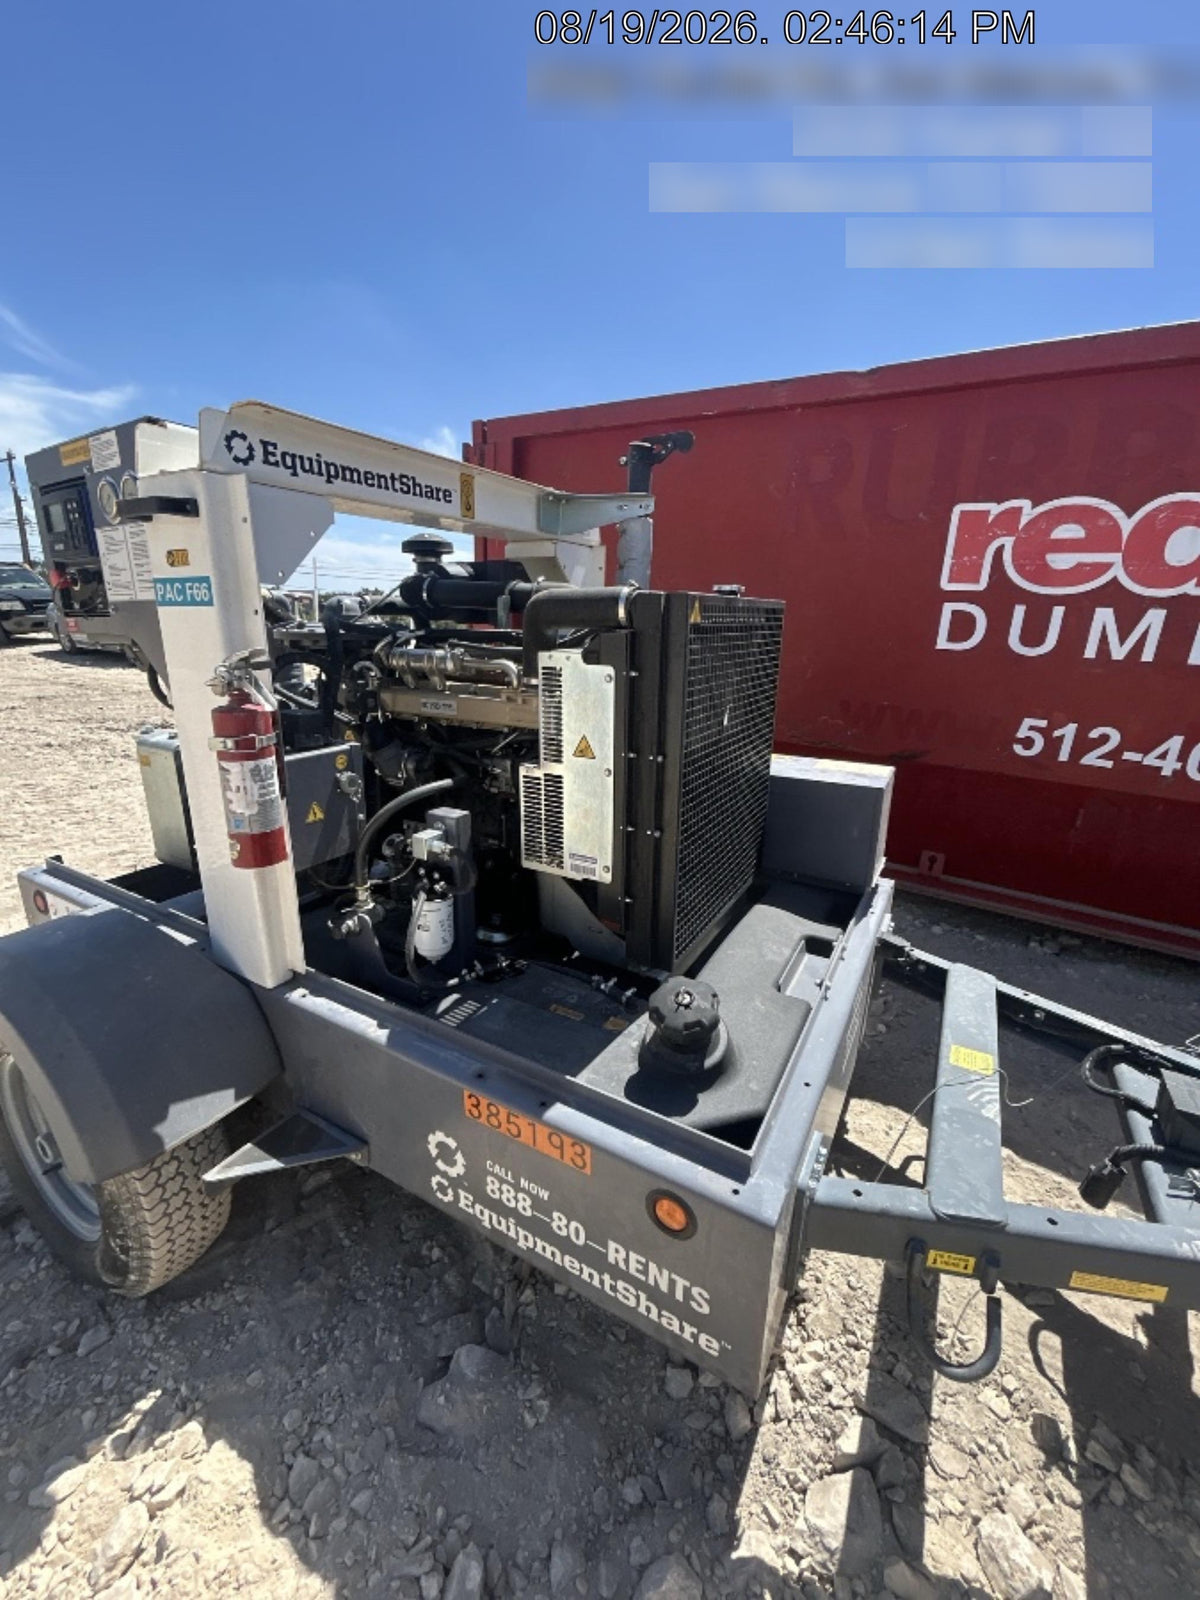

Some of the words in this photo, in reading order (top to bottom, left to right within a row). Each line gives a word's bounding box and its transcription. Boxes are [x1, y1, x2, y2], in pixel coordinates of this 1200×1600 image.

[259, 438, 453, 504] EquipmentShare
[155, 583, 184, 602] PAC
[185, 582, 210, 601] F66
[466, 1093, 589, 1172] 385193
[485, 1160, 515, 1183] CALL
[520, 1178, 550, 1201] NOW
